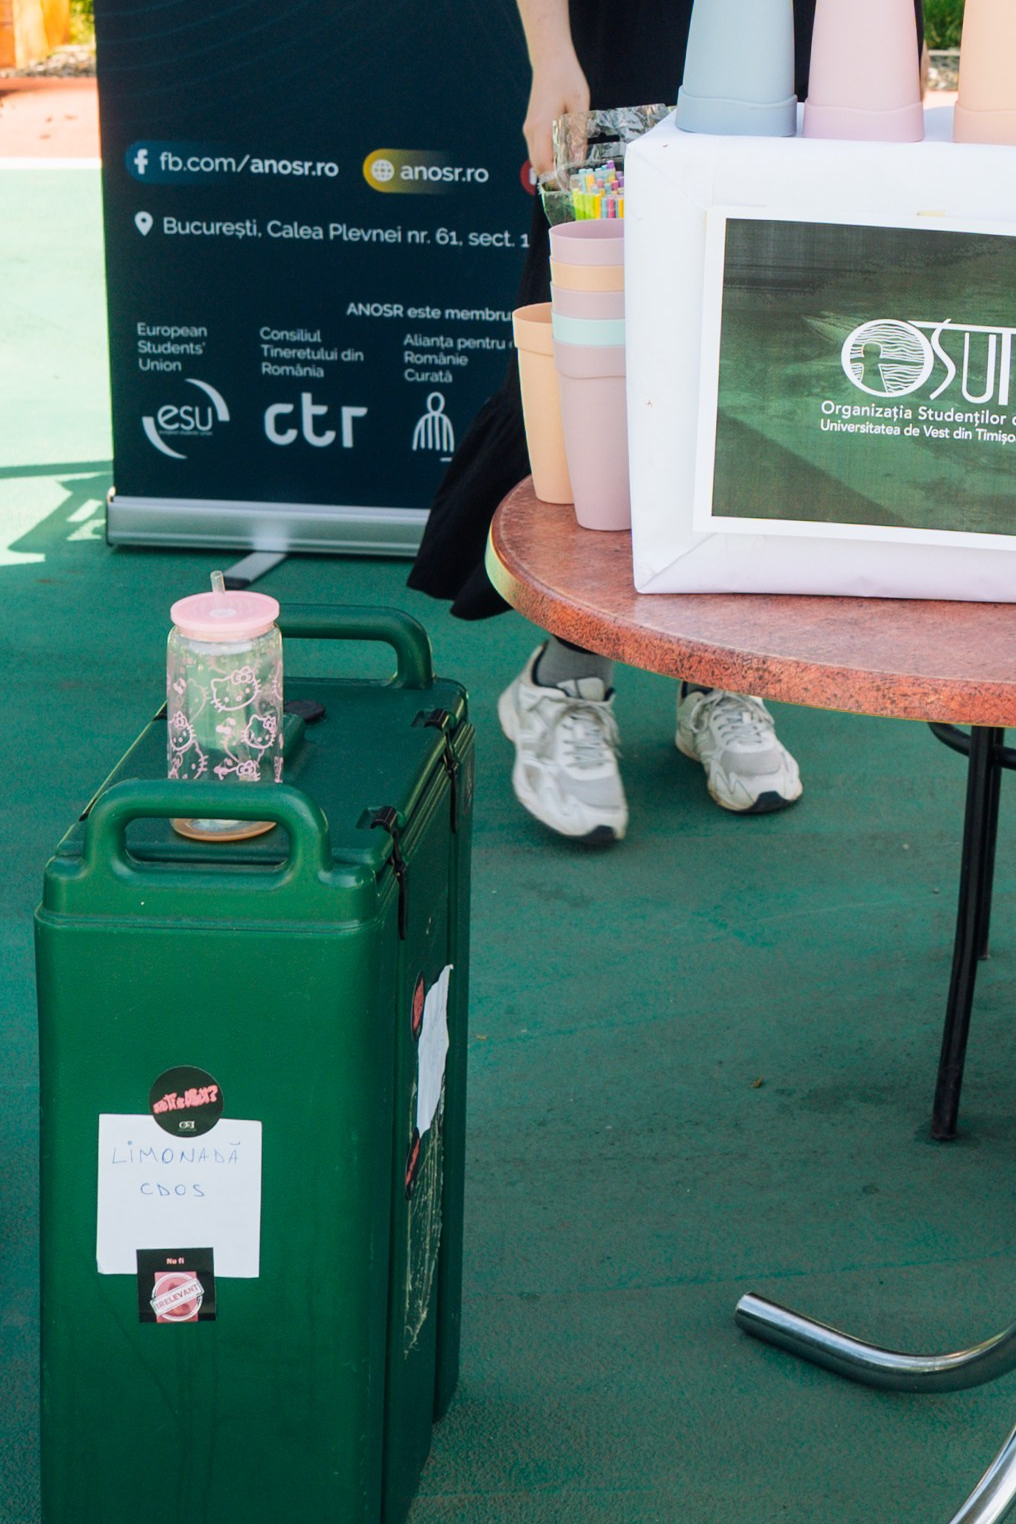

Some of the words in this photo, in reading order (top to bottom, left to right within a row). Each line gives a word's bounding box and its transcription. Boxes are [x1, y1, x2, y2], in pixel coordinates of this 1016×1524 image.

[159, 151, 340, 178] fb.com/anosr.ro
[400, 164, 490, 183] anosr.ro
[163, 216, 262, 240] București,
[266, 219, 324, 240] Calea
[328, 222, 403, 243] Plevnei
[406, 230, 431, 244] nr.
[435, 227, 464, 247] 61,
[468, 230, 515, 248] sect.
[519, 232, 530, 248] 1
[346, 302, 404, 318] ANOSR
[406, 306, 442, 320] este
[444, 306, 513, 322] membru
[136, 321, 208, 340] European
[259, 326, 322, 344] Consiliul
[403, 332, 454, 351] Alianța
[457, 336, 507, 352] pentru
[260, 344, 339, 362] Tineretului
[341, 347, 364, 363] din
[403, 350, 469, 367] Românie
[138, 358, 182, 372] Union
[261, 362, 325, 379] România
[403, 367, 453, 384] Curată
[264, 392, 369, 449] ctr
[820, 400, 913, 422] Organizația
[917, 405, 1007, 427] Studenților
[820, 418, 901, 437] Universitatea
[903, 424, 920, 438] de
[923, 425, 950, 439] Vest
[952, 426, 973, 441] din
